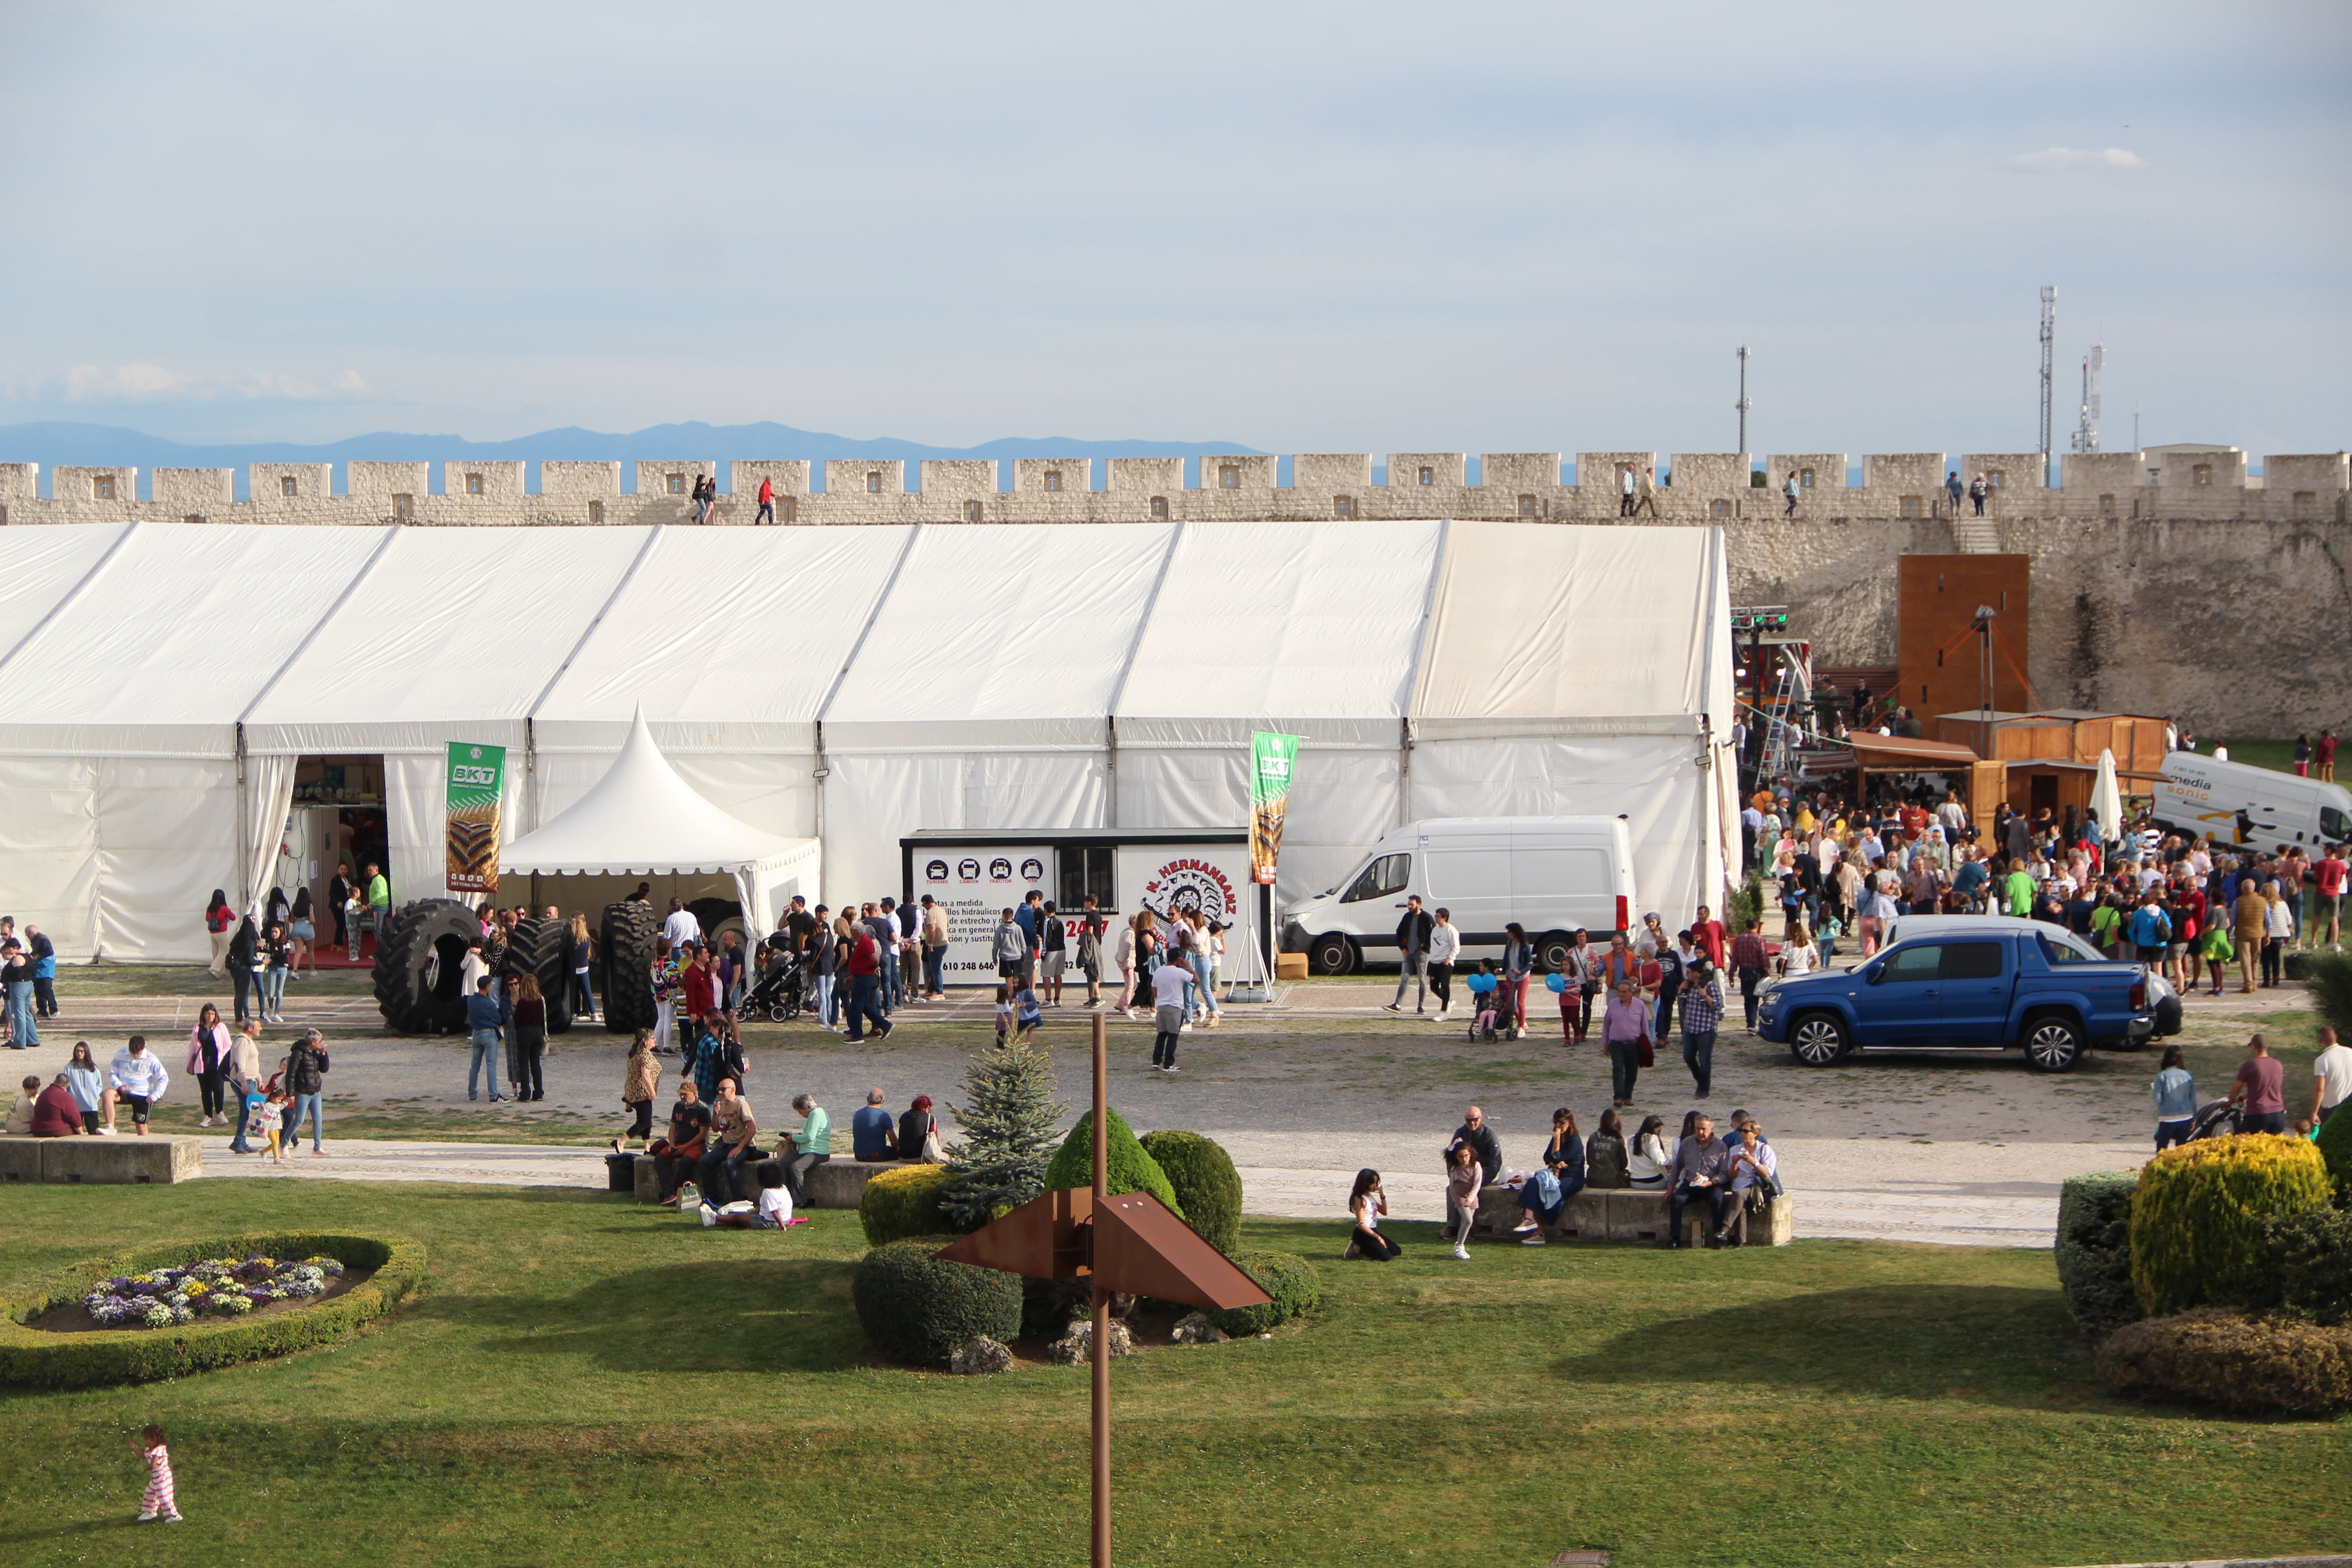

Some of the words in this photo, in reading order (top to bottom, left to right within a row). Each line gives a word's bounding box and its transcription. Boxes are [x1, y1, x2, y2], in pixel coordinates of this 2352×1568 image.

[1261, 758, 1289, 774] BKT
[453, 766, 495, 784] BKT
[2170, 775, 2211, 790] media
[2167, 785, 2209, 801] sonic
[1146, 881, 1161, 893] N.
[1158, 859, 1236, 914] HERNANSANZ
[969, 926, 996, 934] general
[1066, 920, 1109, 937] 247
